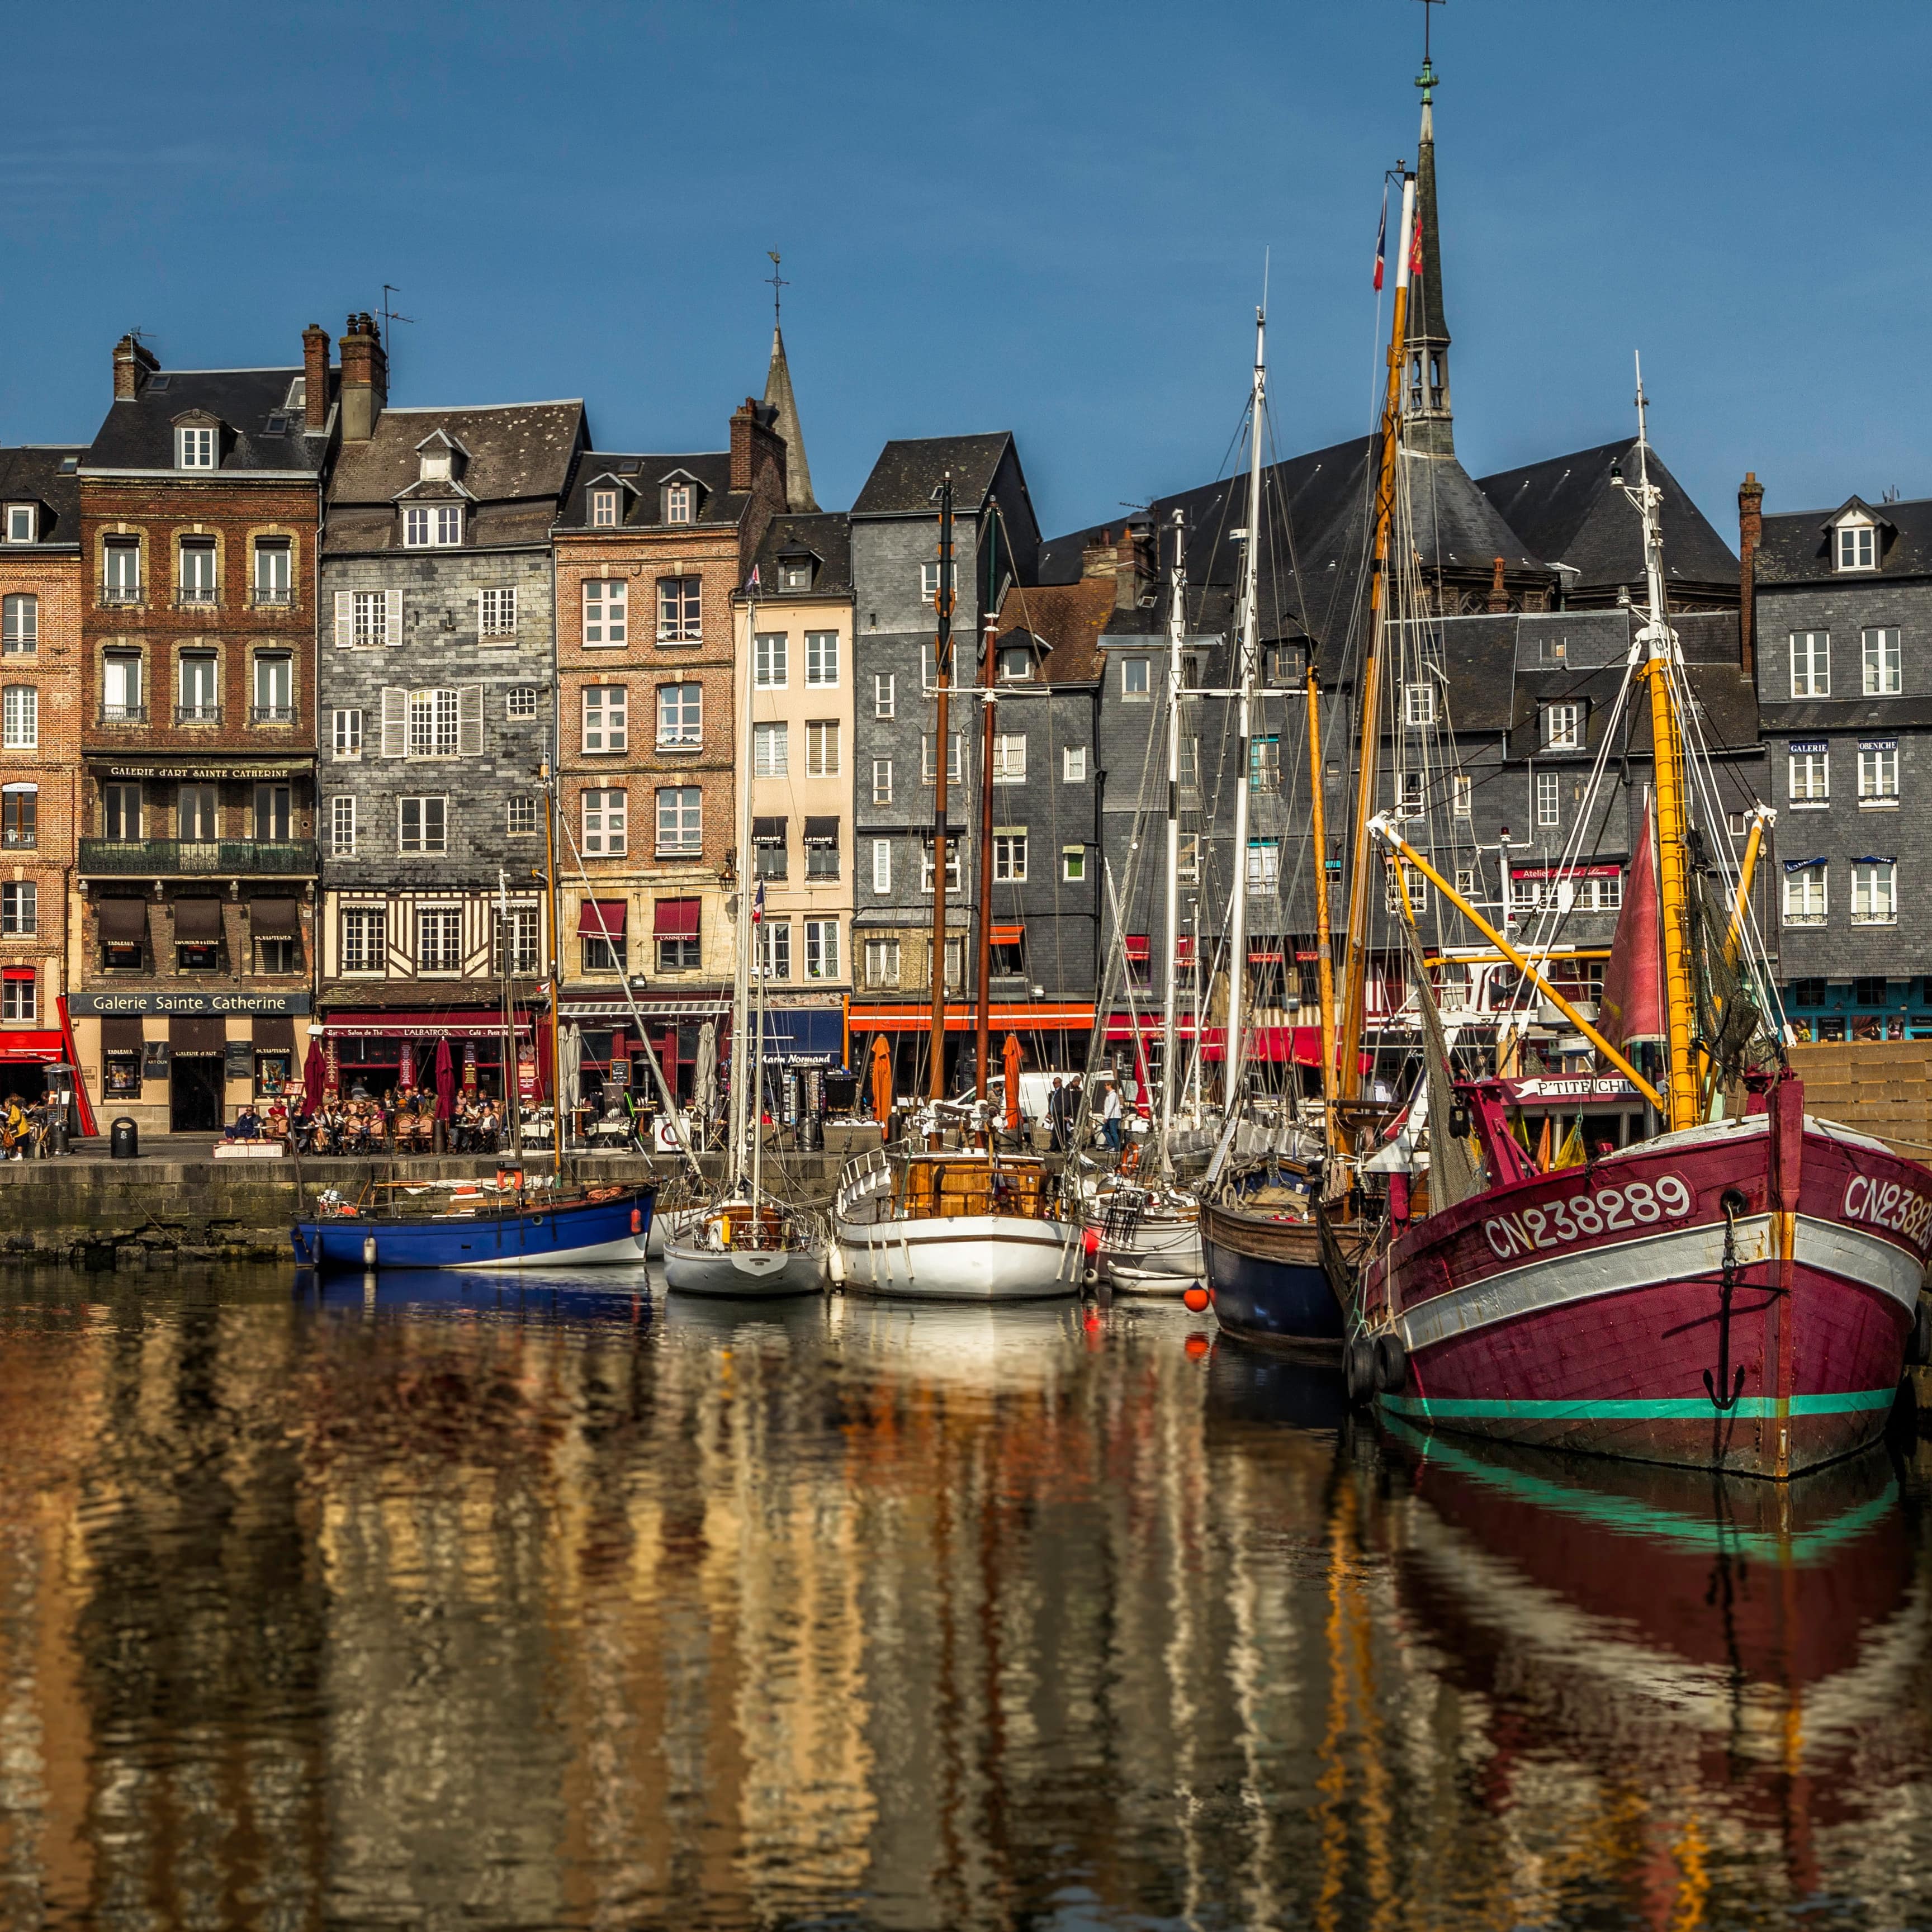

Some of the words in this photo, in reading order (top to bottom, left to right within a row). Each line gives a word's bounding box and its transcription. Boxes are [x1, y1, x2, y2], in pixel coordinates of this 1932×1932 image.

[1791, 744, 1827, 752] GALERIE
[1859, 741, 1896, 750] OBENICHE
[111, 767, 154, 776] GALERIE
[233, 769, 288, 778] CATHERINE
[93, 996, 148, 1009] Galerie
[156, 996, 203, 1009] Sainte
[212, 996, 286, 1009] Catherine
[788, 1053, 831, 1063] Normand
[1538, 1081, 1590, 1095] P'TITE
[1598, 1079, 1639, 1092] CHIN
[1485, 1176, 1690, 1258] CN238289
